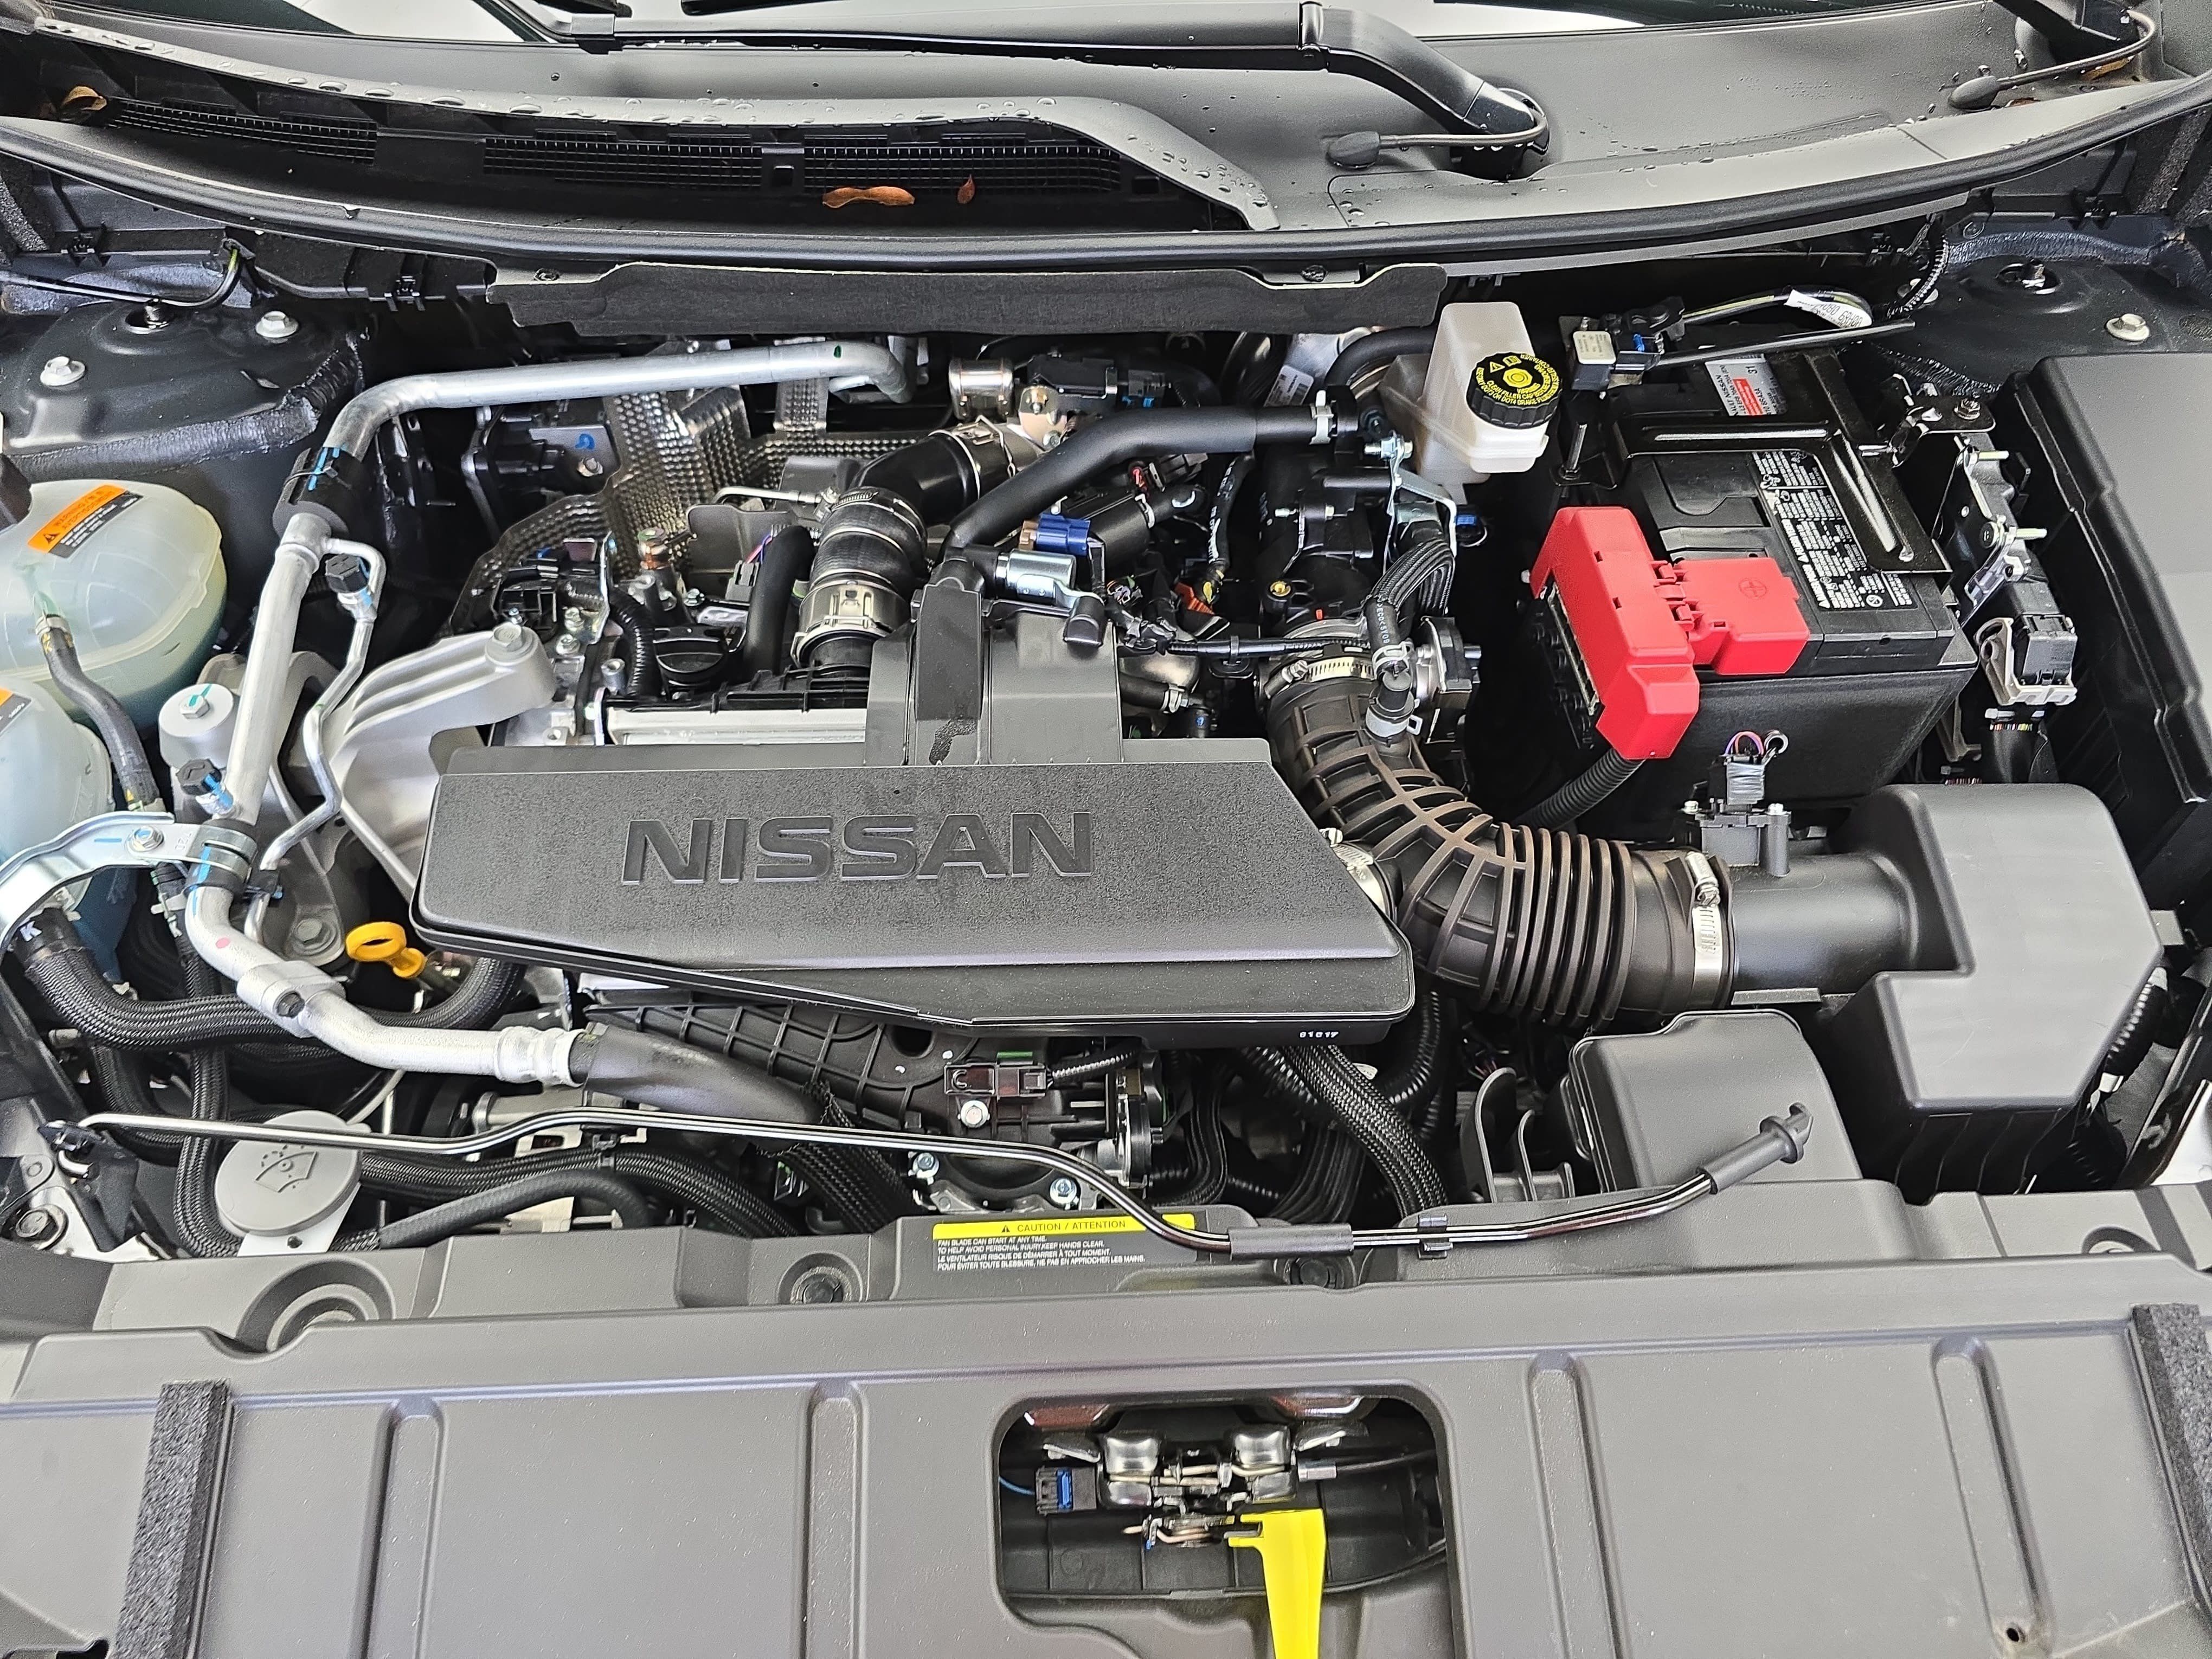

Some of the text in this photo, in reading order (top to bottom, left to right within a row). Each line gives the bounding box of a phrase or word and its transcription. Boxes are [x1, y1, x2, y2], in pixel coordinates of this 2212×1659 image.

[1487, 381, 1502, 395] CLEAN
[1501, 390, 1521, 400] FILLER
[1715, 375, 1731, 398] NISSAN
[1501, 396, 1516, 405] DOT4
[621, 812, 1094, 886] NISSAN
[1017, 1223, 1060, 1232] CAUTION
[1072, 1220, 1126, 1230] ATTENTION
[986, 1244, 1019, 1252] PERSONAL
[947, 1252, 987, 1262] VENTILATEUR
[988, 1252, 1012, 1261] RISQUE
[1023, 1249, 1058, 1259] DÉMARRER
[937, 1263, 956, 1271] POUR
[979, 1261, 1000, 1269] TOUTE
[1060, 1257, 1069, 1265] EN
[1070, 1256, 1110, 1265] APPROCHER
